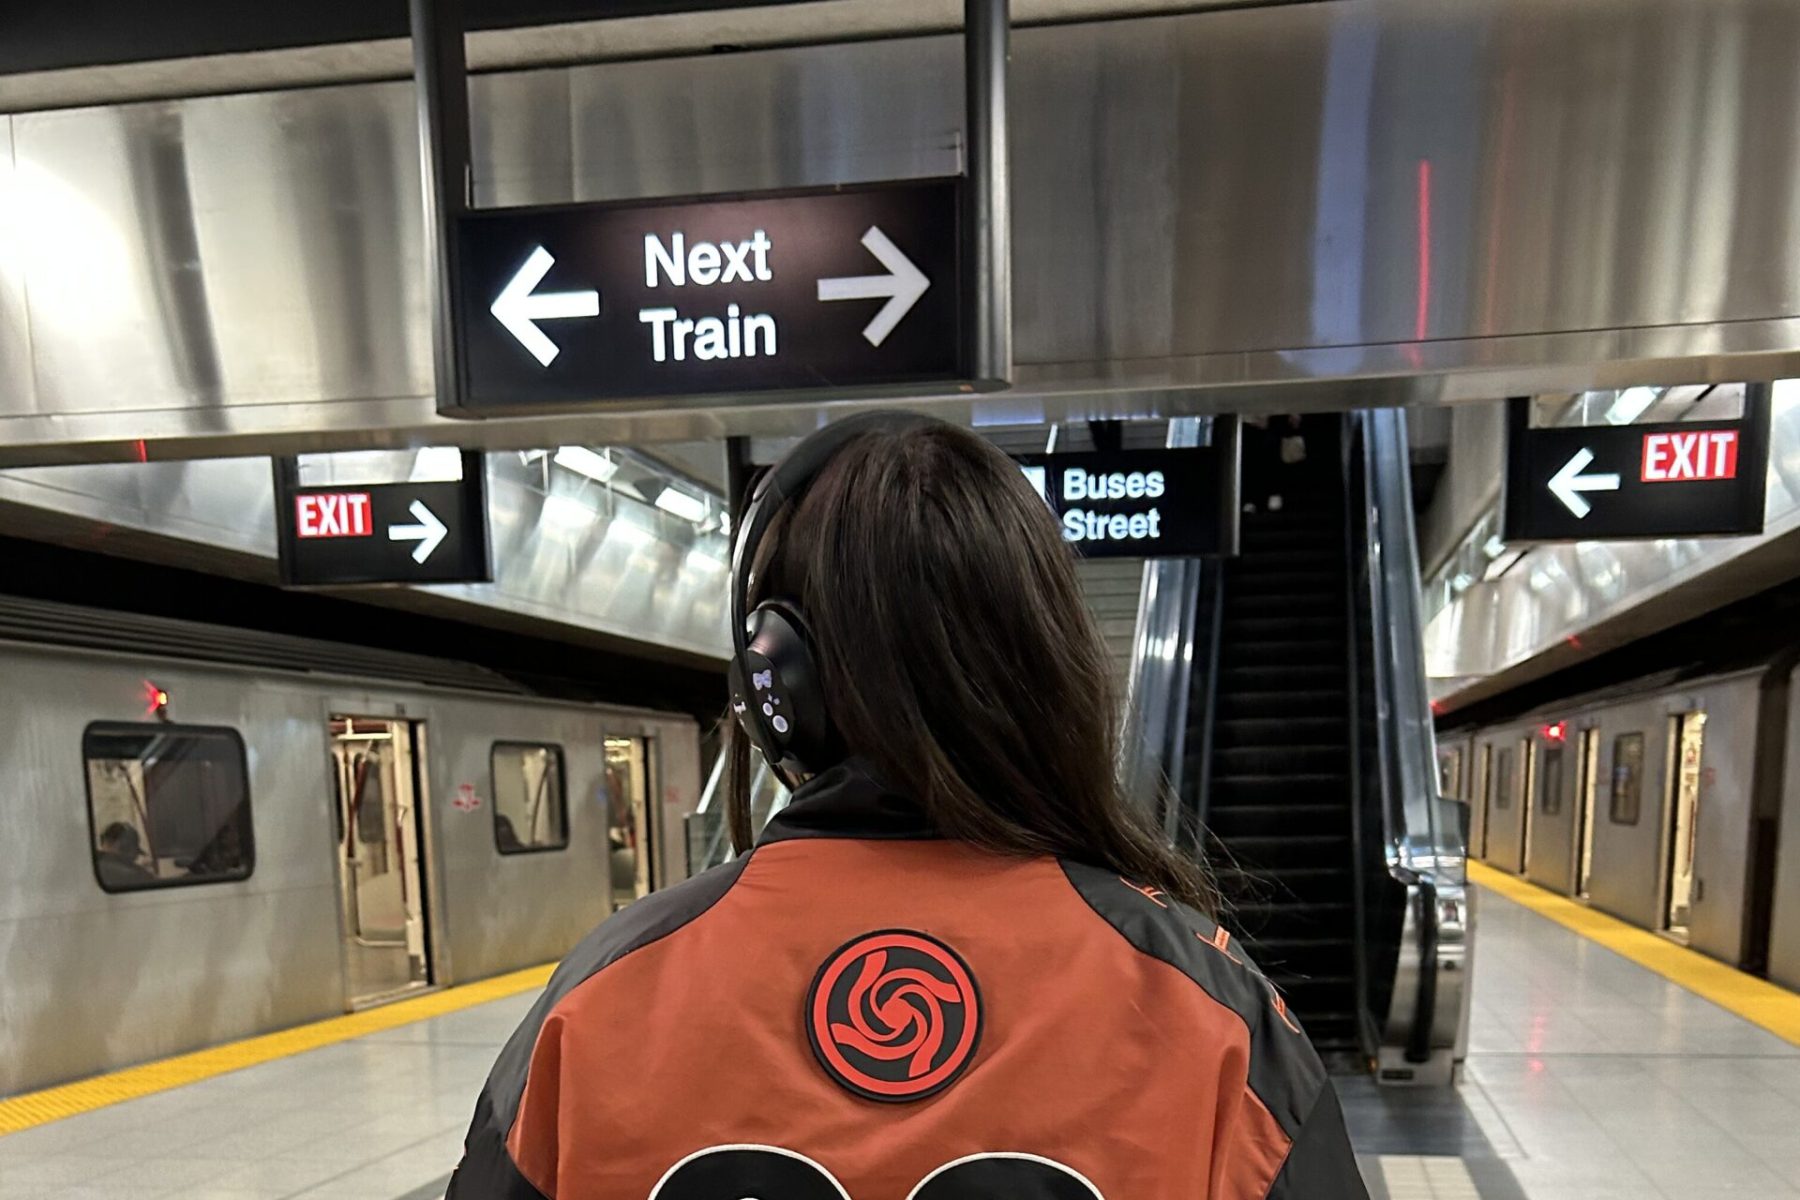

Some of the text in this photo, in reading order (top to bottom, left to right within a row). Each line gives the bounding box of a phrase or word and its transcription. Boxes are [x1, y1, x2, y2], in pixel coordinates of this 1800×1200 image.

[645, 229, 772, 287] Next
[639, 303, 777, 361] Train
[1644, 431, 1735, 479] EXIT
[1063, 468, 1165, 500] Buses
[298, 493, 368, 535] EXIT
[1063, 508, 1160, 541] Street
